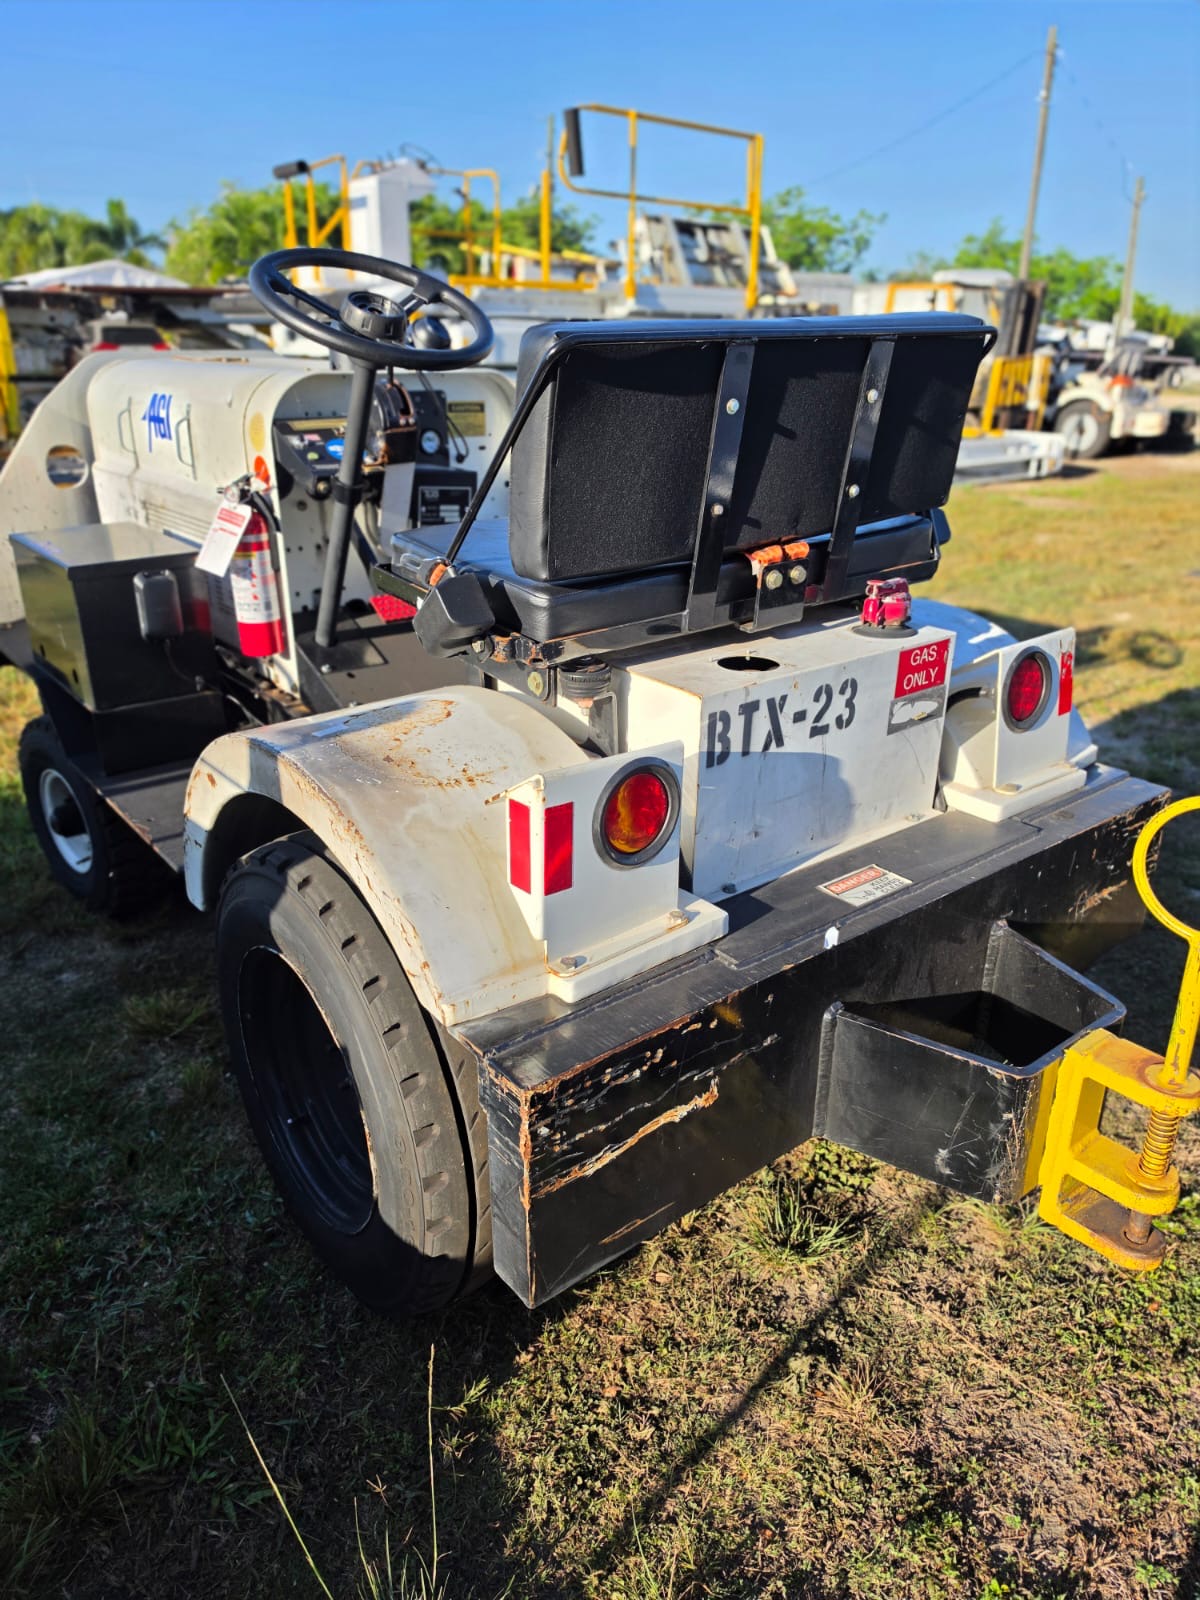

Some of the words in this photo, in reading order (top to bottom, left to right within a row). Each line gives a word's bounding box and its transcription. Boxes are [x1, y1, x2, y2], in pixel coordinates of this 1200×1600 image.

[910, 645, 938, 666] GAS
[903, 666, 939, 690] ONLY
[705, 677, 858, 769] BTX-23
[829, 868, 881, 892] DANGER
